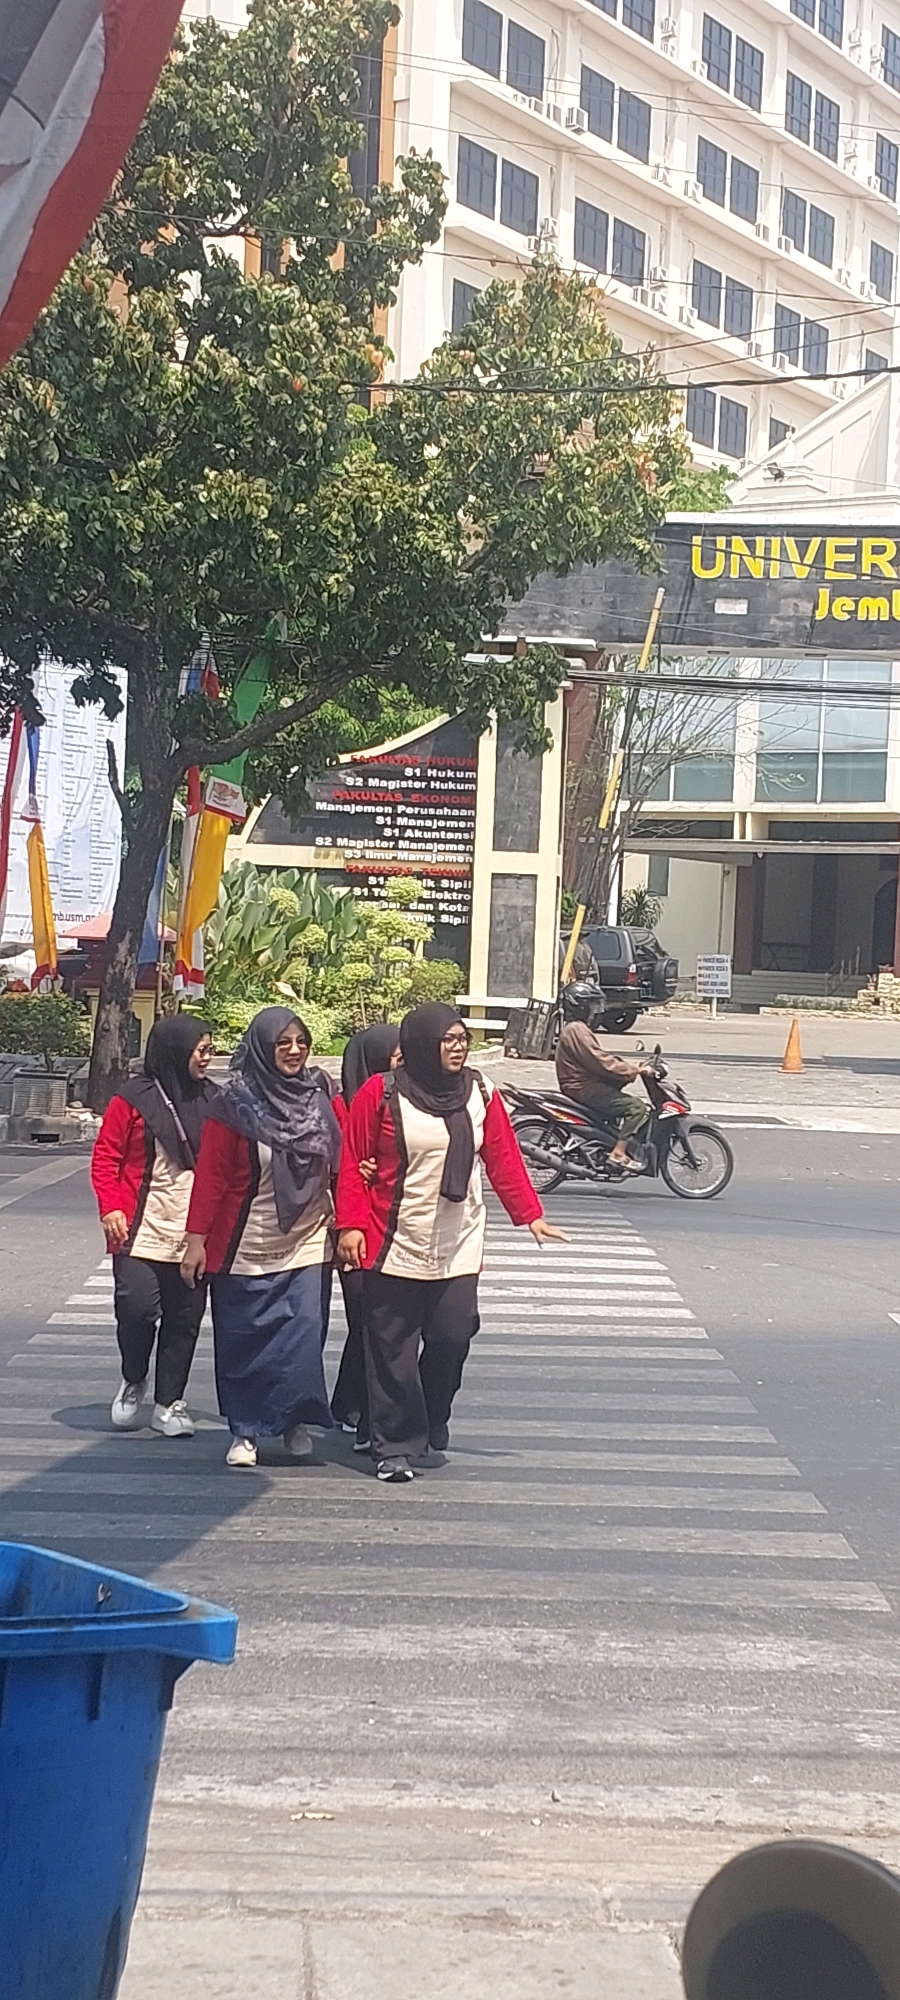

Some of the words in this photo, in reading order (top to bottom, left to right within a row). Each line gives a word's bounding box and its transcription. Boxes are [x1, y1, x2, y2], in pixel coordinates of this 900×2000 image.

[691, 535, 899, 579] UNIVER
[426, 756, 477, 767] HUKUM
[404, 767, 421, 777] S1
[427, 768, 477, 779] Hukum
[345, 776, 363, 787] S2
[368, 777, 428, 790] Magister
[430, 780, 477, 791] Hukum
[333, 790, 403, 802] FAKULTAS
[315, 802, 393, 814] Manajemen
[397, 805, 476, 817] Perusahaan
[375, 815, 392, 825] S1
[396, 817, 475, 829] Manajemen
[383, 828, 400, 837] S1
[404, 828, 475, 840] Akuntansi
[315, 836, 333, 846] S2
[336, 838, 396, 849] Magister
[398, 840, 474, 853] Manajemen
[344, 849, 362, 859] S3
[365, 850, 393, 860] Ilmu
[397, 851, 473, 864] Manajemen
[367, 876, 385, 885] S1
[440, 879, 472, 890] Sipil
[352, 887, 369, 897] S1
[422, 890, 471, 900] Elektro
[409, 901, 434, 911] dan
[438, 902, 470, 912] Kota
[440, 914, 469, 926] Sipil
